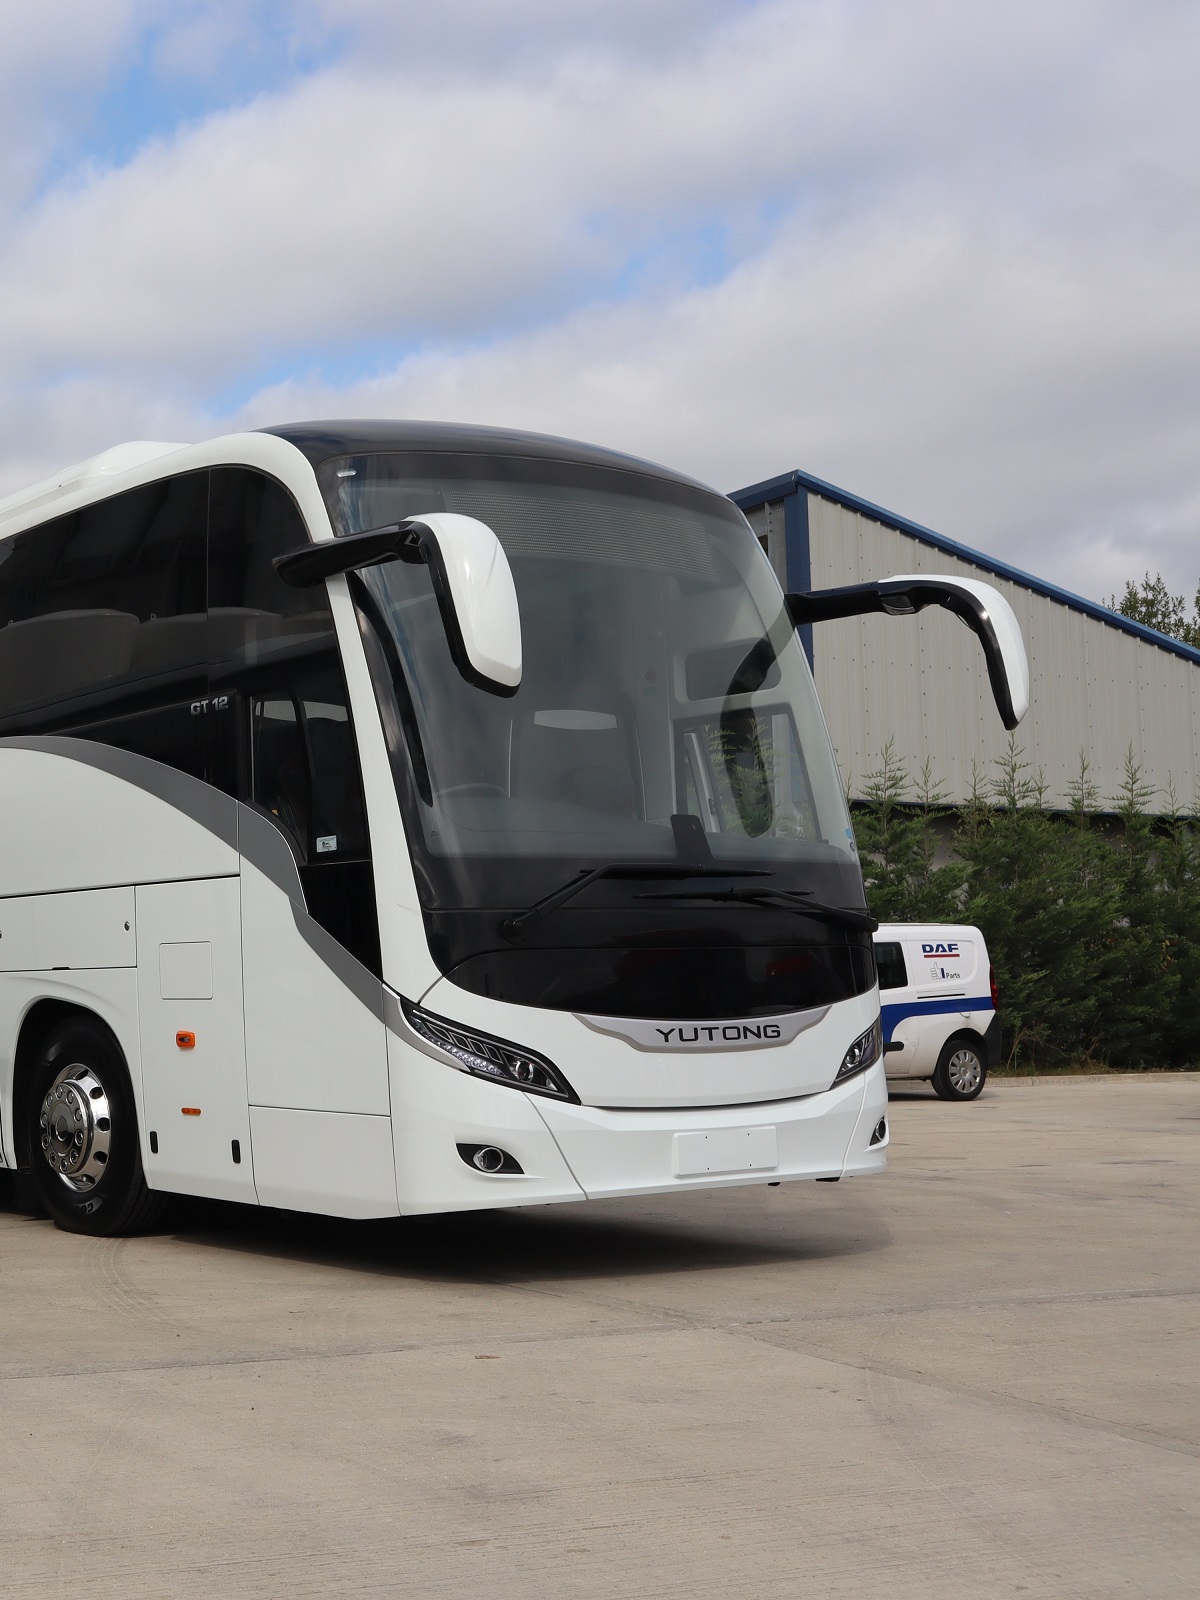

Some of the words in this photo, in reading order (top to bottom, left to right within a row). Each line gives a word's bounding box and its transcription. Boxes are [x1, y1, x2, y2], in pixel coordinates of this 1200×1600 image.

[191, 701, 209, 715] GT
[212, 696, 228, 711] 12
[921, 943, 959, 953] DAF
[655, 1024, 781, 1043] YUTONG
